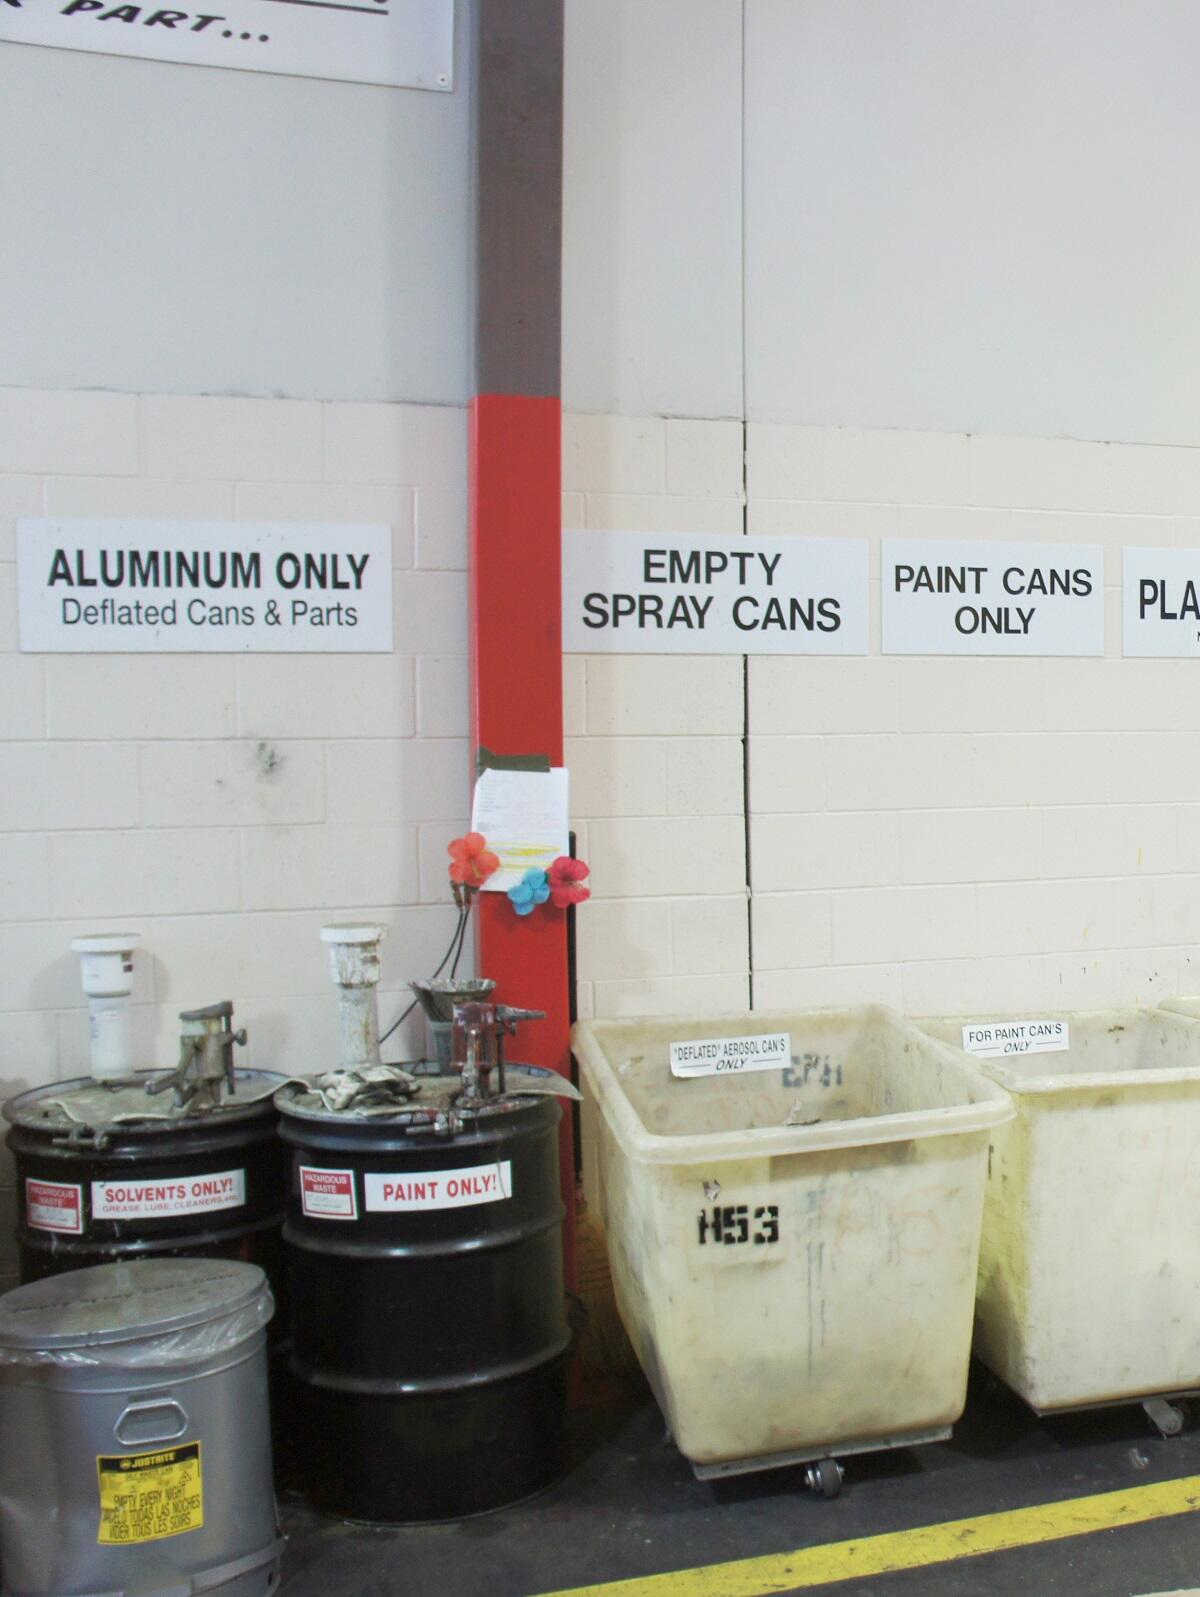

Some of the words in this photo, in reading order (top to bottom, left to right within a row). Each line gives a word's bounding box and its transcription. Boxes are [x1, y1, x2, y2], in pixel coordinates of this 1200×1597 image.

[47, 549, 261, 589] ALUMINUM
[275, 552, 370, 590] ONLY
[643, 548, 782, 586] EMPTY
[895, 565, 988, 594] PAINT
[1003, 567, 1092, 597] CANS
[61, 598, 177, 625] Deflated
[187, 599, 255, 626] Cans
[264, 600, 281, 625] &
[291, 600, 358, 626] Parts
[582, 592, 714, 629] SPRAY
[732, 596, 841, 633] CANS
[955, 606, 1036, 634] ONLY
[969, 1030, 992, 1043] FOR
[995, 1026, 1025, 1040] PAINT
[1028, 1023, 1062, 1037] CAN'S
[723, 1040, 760, 1056] AEROSOL
[761, 1038, 785, 1053] CAN'S
[1003, 1040, 1032, 1053] ONLY
[716, 1057, 748, 1071] ONLY
[105, 1185, 186, 1203] SOLVENTS
[191, 1178, 233, 1197] ONLY!
[304, 1173, 347, 1185] HAZARDOUS
[312, 1183, 337, 1194] WASTE
[383, 1182, 438, 1202] PAINT
[446, 1173, 497, 1198] ONLY!
[698, 1205, 779, 1245] H53
[131, 1451, 176, 1469] JUSTRITE
[130, 1503, 154, 1521] TODAS
[155, 1502, 170, 1519] LAS
[172, 1494, 200, 1514] NOCHES
[139, 1489, 163, 1508] EVERY
[165, 1484, 186, 1501] NIGHT
[132, 1521, 153, 1538] TOUS
[154, 1519, 168, 1535] LES
[170, 1513, 192, 1531] SOIRS
